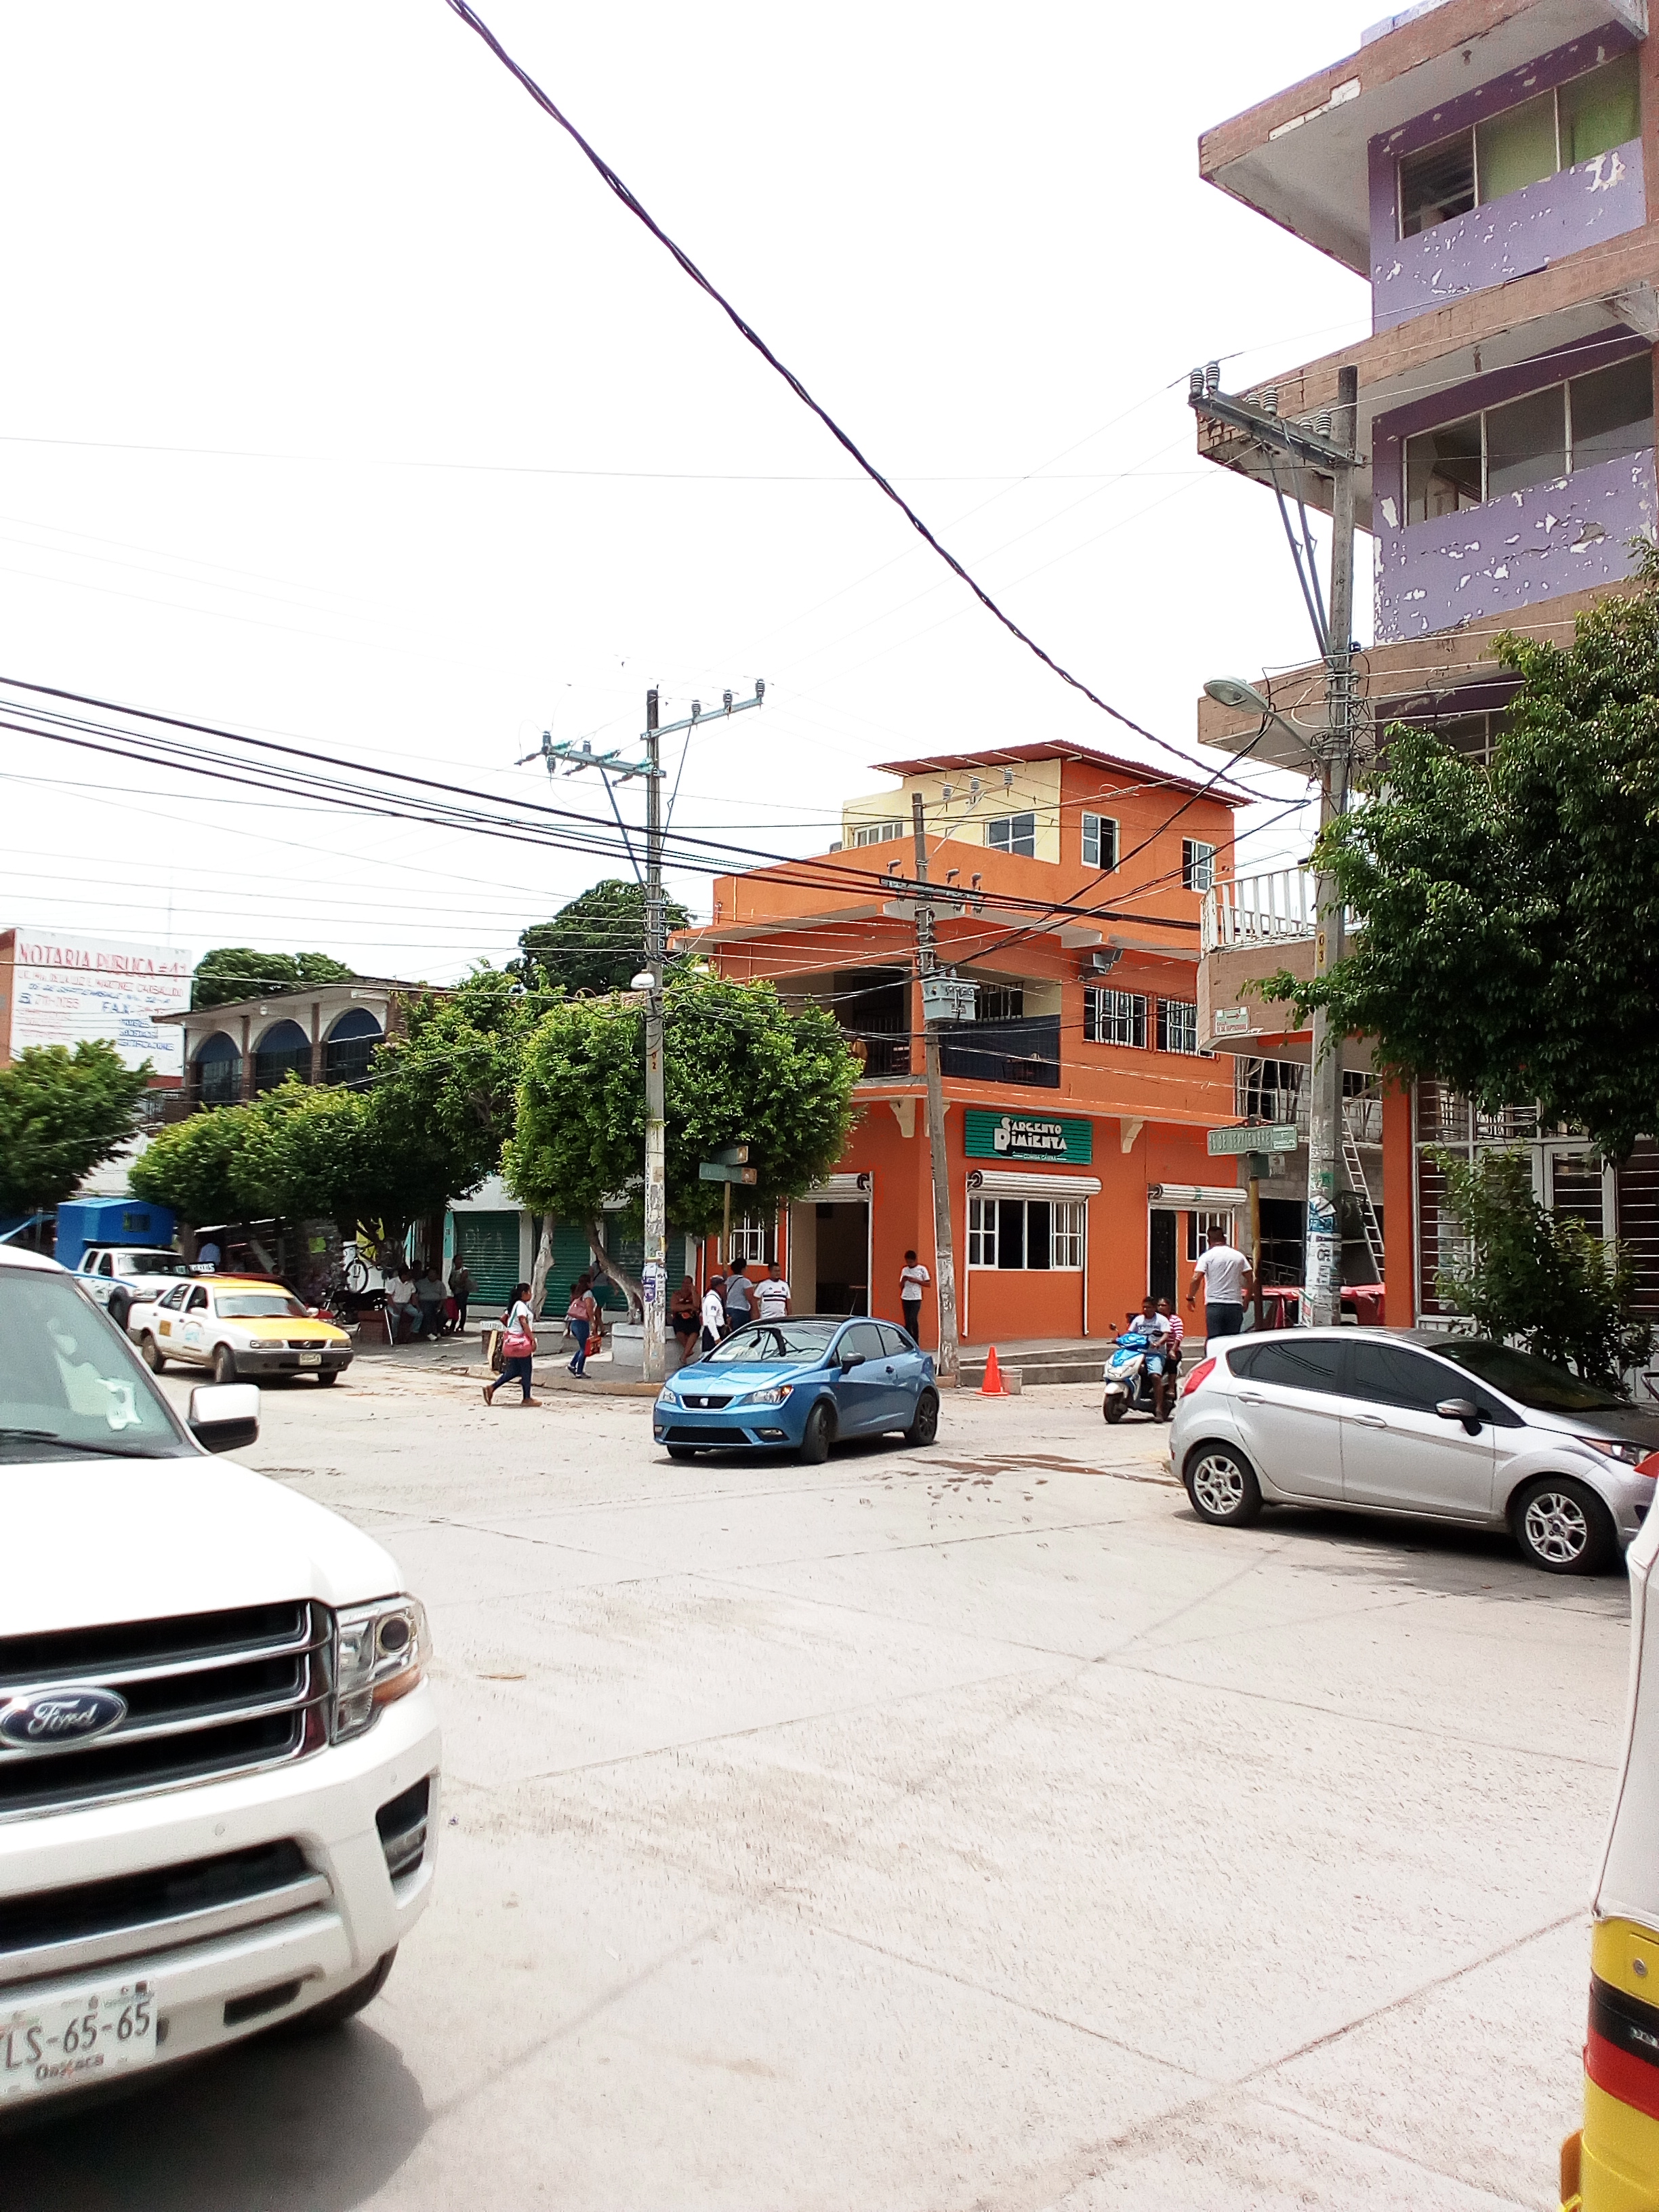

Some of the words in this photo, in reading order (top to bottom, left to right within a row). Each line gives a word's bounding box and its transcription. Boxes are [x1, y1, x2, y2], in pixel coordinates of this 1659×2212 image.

[18, 942, 90, 969] NOTARIA
[102, 1001, 130, 1015] FAX
[1000, 1116, 1063, 1135] SARGENTO
[28, 1698, 99, 1735] Ford
